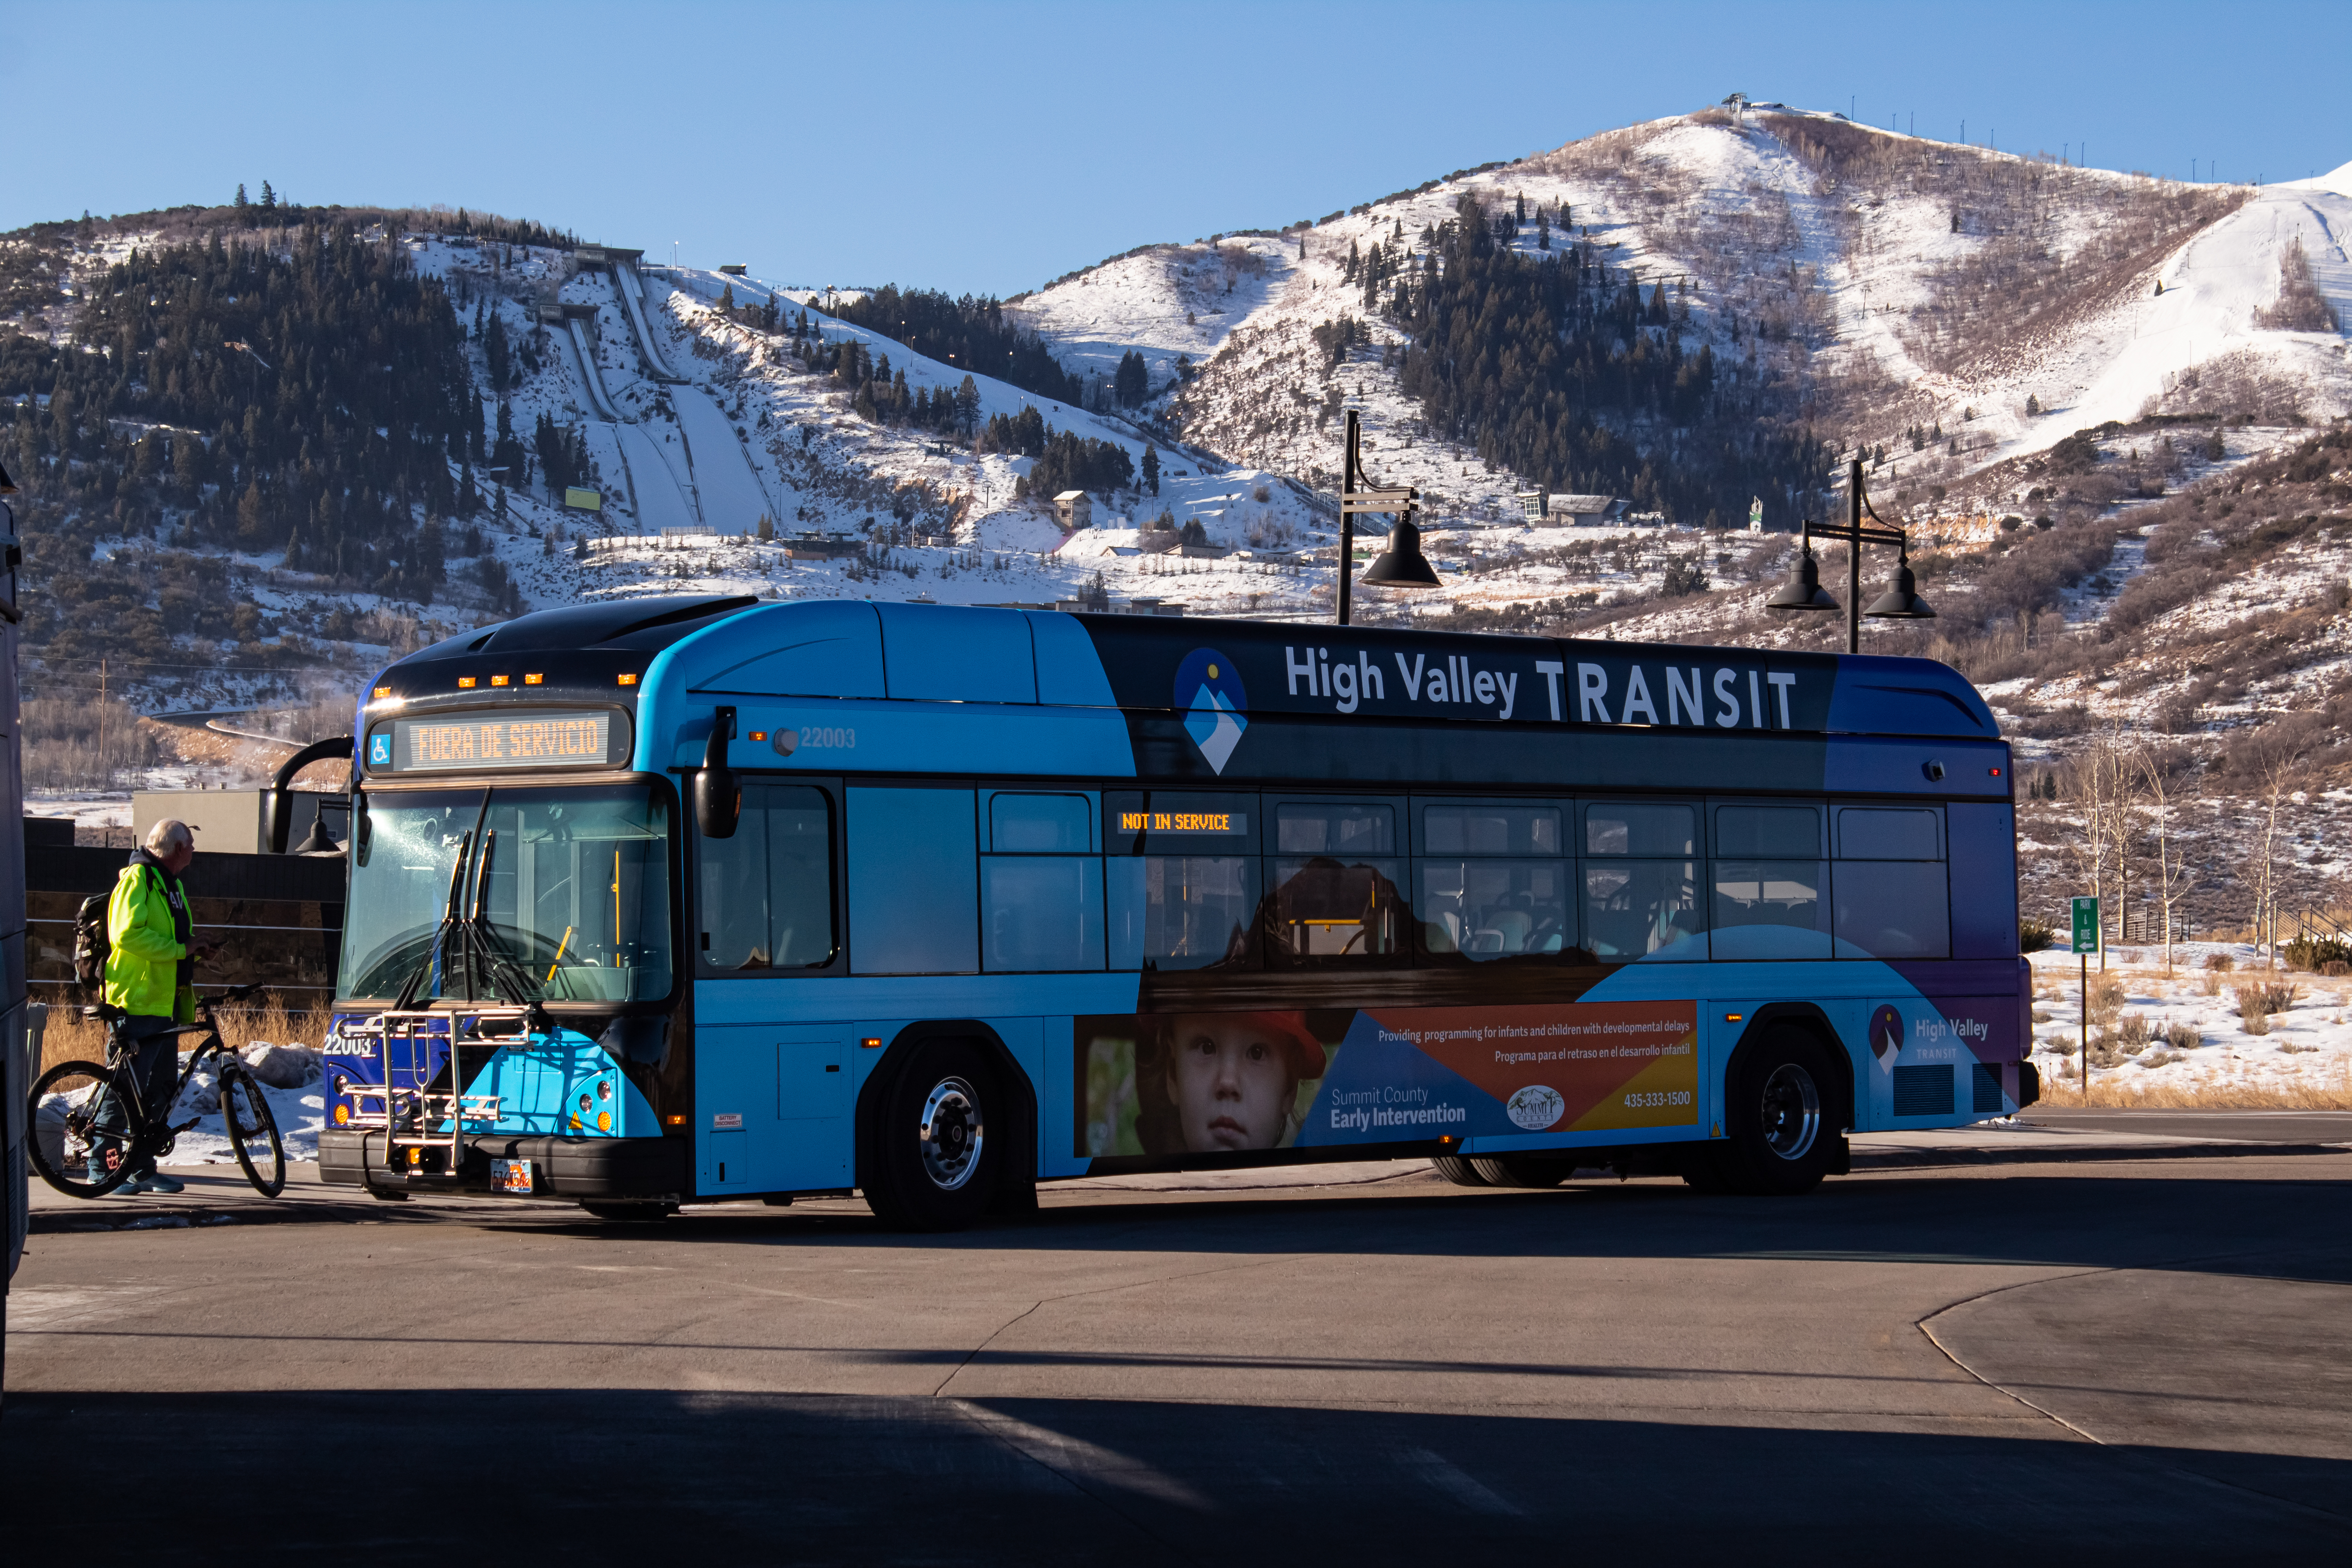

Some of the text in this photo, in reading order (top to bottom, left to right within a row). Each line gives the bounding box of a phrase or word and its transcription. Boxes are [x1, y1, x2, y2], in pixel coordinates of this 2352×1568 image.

[1286, 647, 1796, 729] High Valley TRANSIT
[419, 721, 598, 760] FUERA DE SERVICIO
[801, 726, 855, 749] 22003
[1122, 813, 1230, 830] NOT IN SERVICE
[2080, 899, 2091, 910] PARK
[2084, 914, 2087, 925] &
[2081, 929, 2091, 940] RIDE
[1379, 1020, 1690, 1044] Providing programming for infants and children with developmental delays
[1916, 1019, 1988, 1042] High Valley
[323, 1034, 371, 1055] 22003
[1495, 1043, 1690, 1064] Programa para el retraso en el desarrollo infantil
[1916, 1048, 1956, 1059] TRANSIT
[1332, 1086, 1428, 1105] Summit County
[1624, 1091, 1690, 1107] 435-333-1500
[1516, 1097, 1556, 1115] SUMMIT
[1331, 1102, 1465, 1132] Early Intervention
